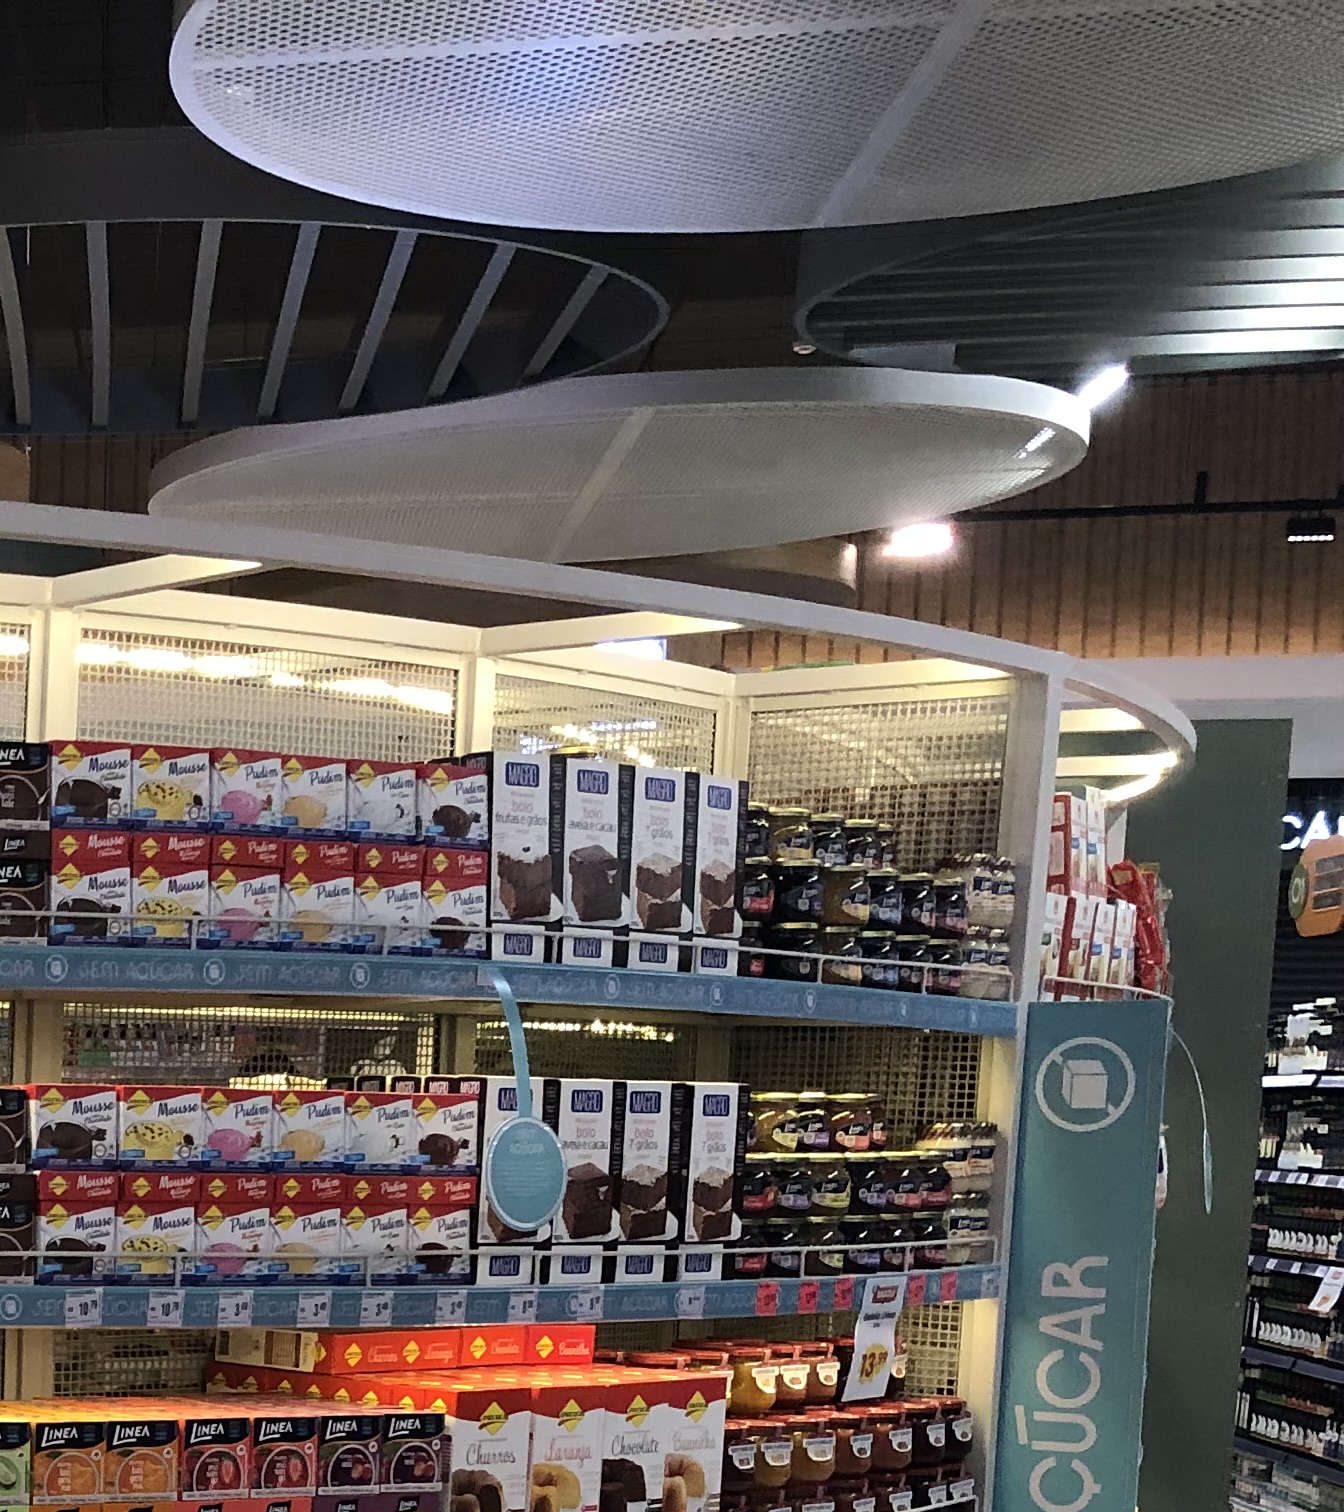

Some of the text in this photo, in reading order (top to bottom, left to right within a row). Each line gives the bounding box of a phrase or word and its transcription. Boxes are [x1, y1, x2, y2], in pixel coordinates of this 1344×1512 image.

[88, 757, 129, 773] Mousse
[169, 760, 207, 776] Mousse
[73, 1099, 114, 1116] Mousse
[41, 1425, 78, 1446] LINEA
[611, 1435, 659, 1456] Chocolate
